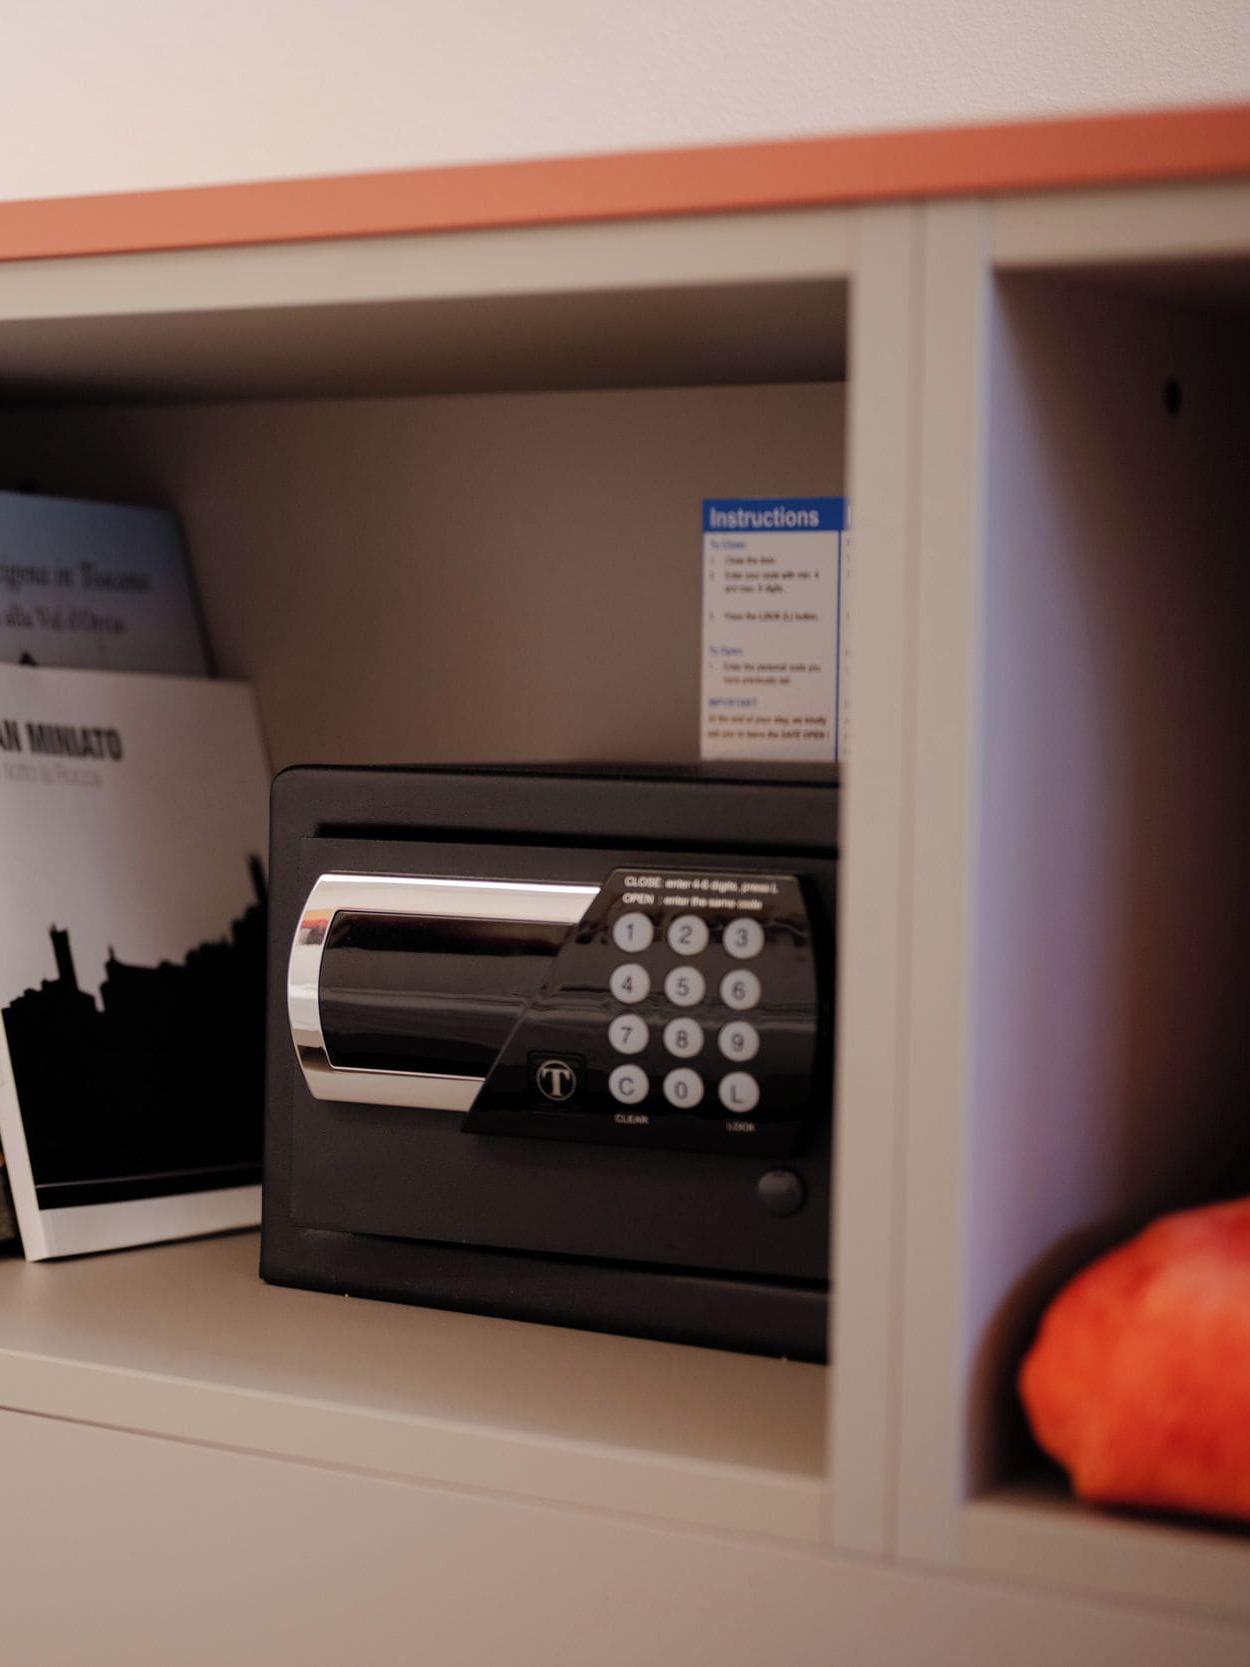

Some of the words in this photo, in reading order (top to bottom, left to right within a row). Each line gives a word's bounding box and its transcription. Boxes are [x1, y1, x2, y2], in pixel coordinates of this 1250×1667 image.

[710, 505, 819, 528] Instructions
[26, 722, 123, 762] MINIATO
[622, 893, 654, 904] OPEN
[626, 923, 634, 941] 1
[679, 925, 693, 944] 2
[736, 928, 748, 947] 3
[621, 976, 633, 993] 4
[677, 978, 689, 996] 5
[733, 981, 745, 999] 6
[621, 1027, 633, 1044] 7
[676, 1030, 688, 1048] 8
[731, 1033, 743, 1051] 9
[618, 1077, 634, 1095] C
[730, 1085, 741, 1103] L
[615, 1113, 649, 1124] CLEAR
